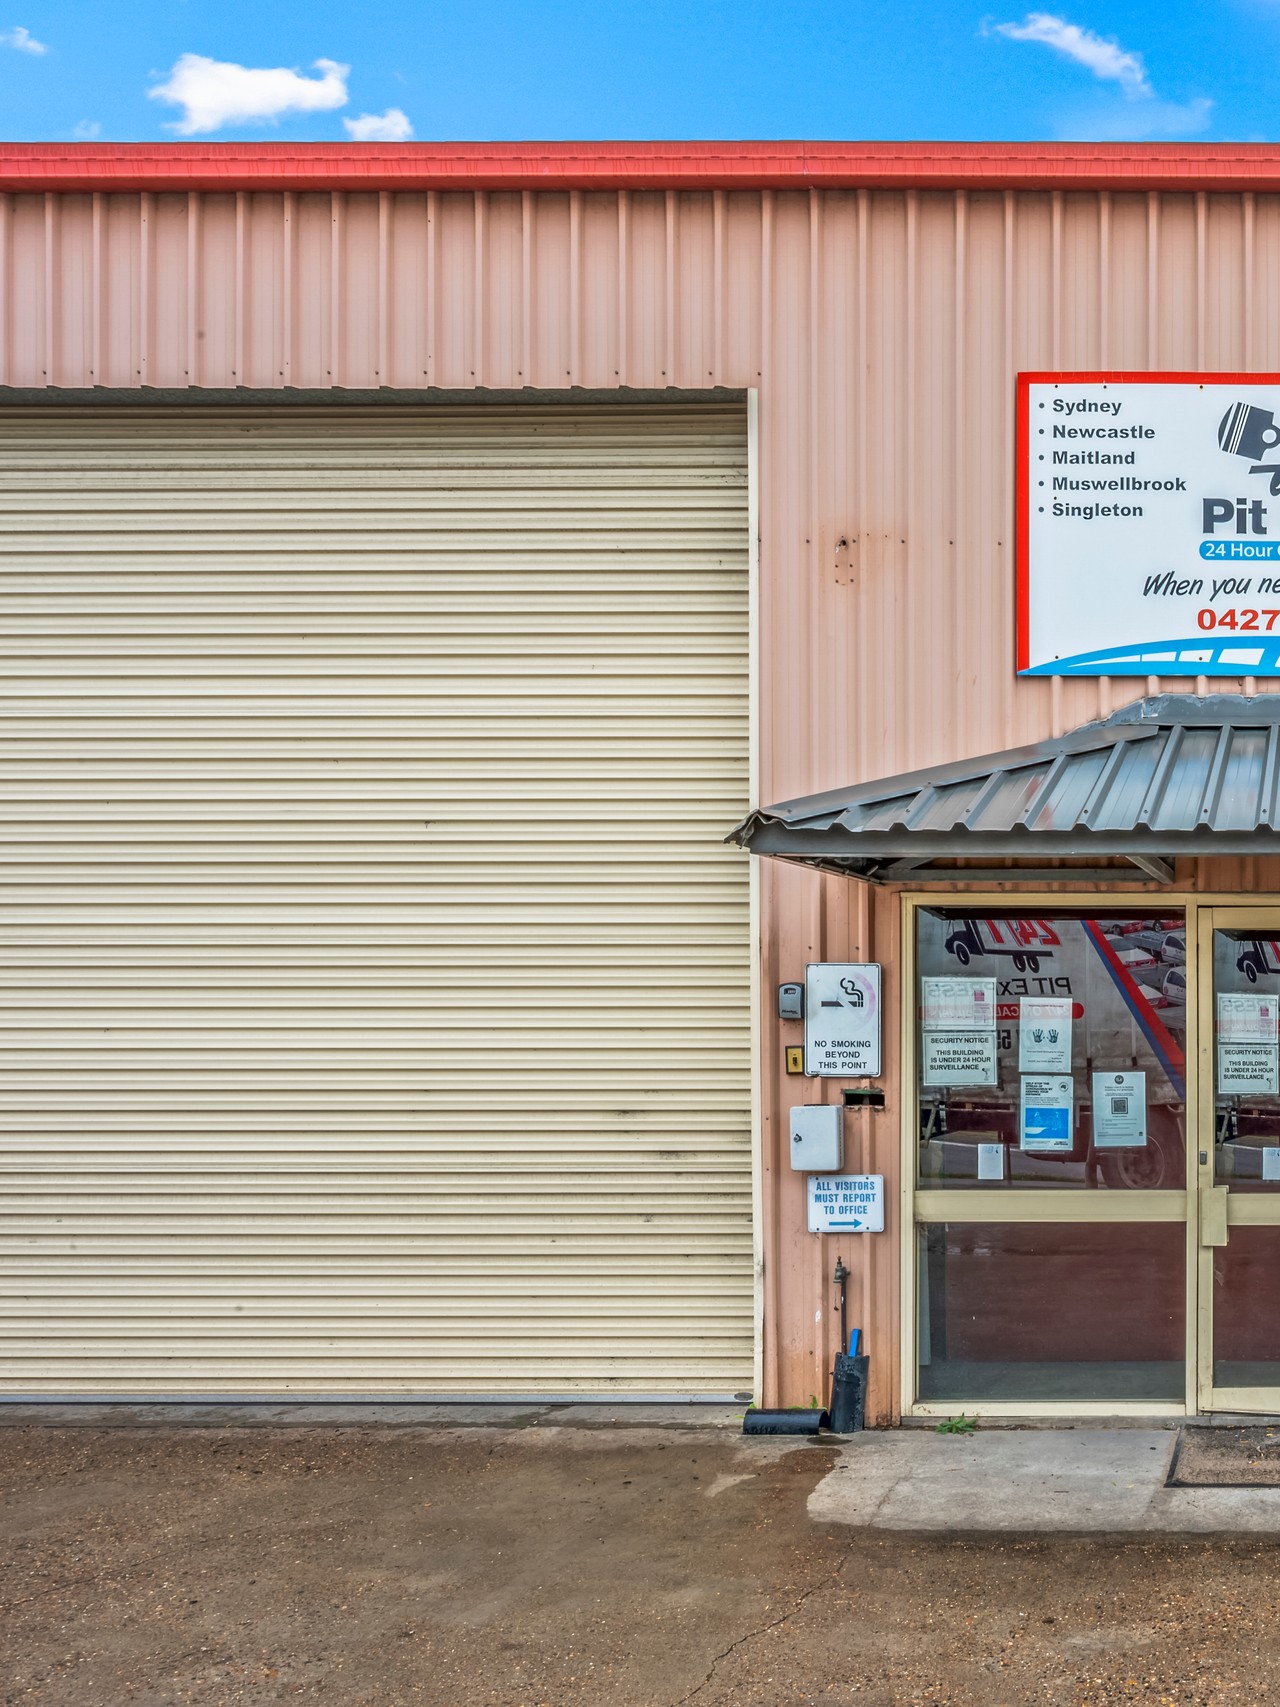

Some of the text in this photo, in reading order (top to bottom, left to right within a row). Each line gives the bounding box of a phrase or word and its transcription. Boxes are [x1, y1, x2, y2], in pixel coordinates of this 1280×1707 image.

[1052, 398, 1122, 416] Sydney
[1052, 424, 1156, 439] Newcastle
[1052, 450, 1136, 465] Maitland
[1052, 476, 1187, 491] Muswellbrook
[1052, 502, 1143, 520] Singleton
[1202, 497, 1268, 535] Pit
[1204, 543, 1227, 557] 24
[1230, 543, 1274, 558] Hour
[1143, 571, 1204, 598] When
[1211, 575, 1252, 603] you
[1197, 608, 1280, 632] 0427
[814, 1040, 871, 1048] NO SMOKING
[818, 1061, 868, 1069] THIS POINT
[816, 1181, 875, 1191] ALL VISITORS
[814, 1193, 877, 1203] MUST REPORT
[823, 1205, 868, 1215] TO OFFICE
